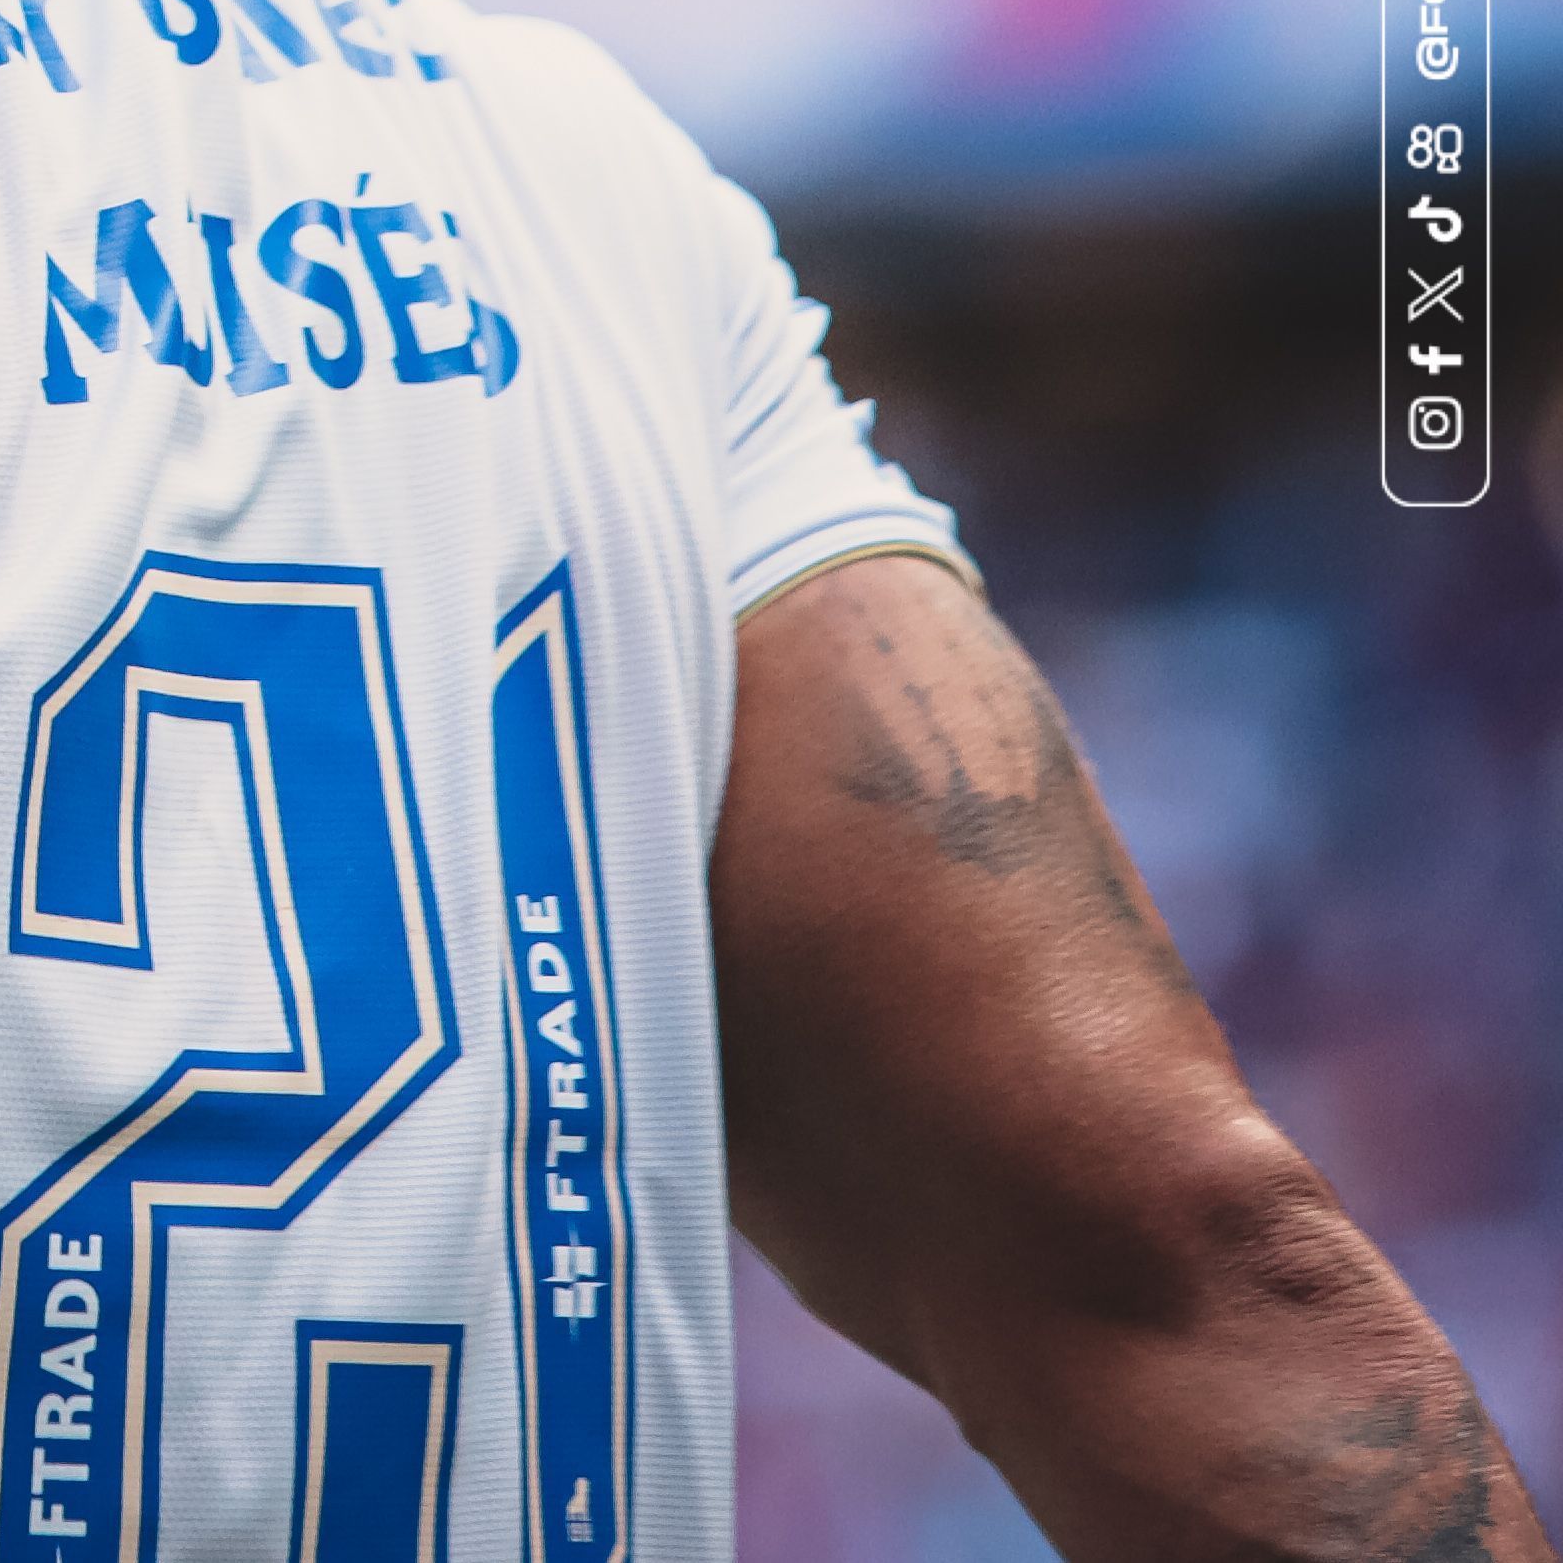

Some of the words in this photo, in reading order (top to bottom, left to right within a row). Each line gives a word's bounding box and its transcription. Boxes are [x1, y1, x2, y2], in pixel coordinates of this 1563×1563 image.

[41, 172, 521, 406] MISÉ
[515, 893, 590, 1213] FTRADE
[28, 1232, 104, 1538] FTRADE
